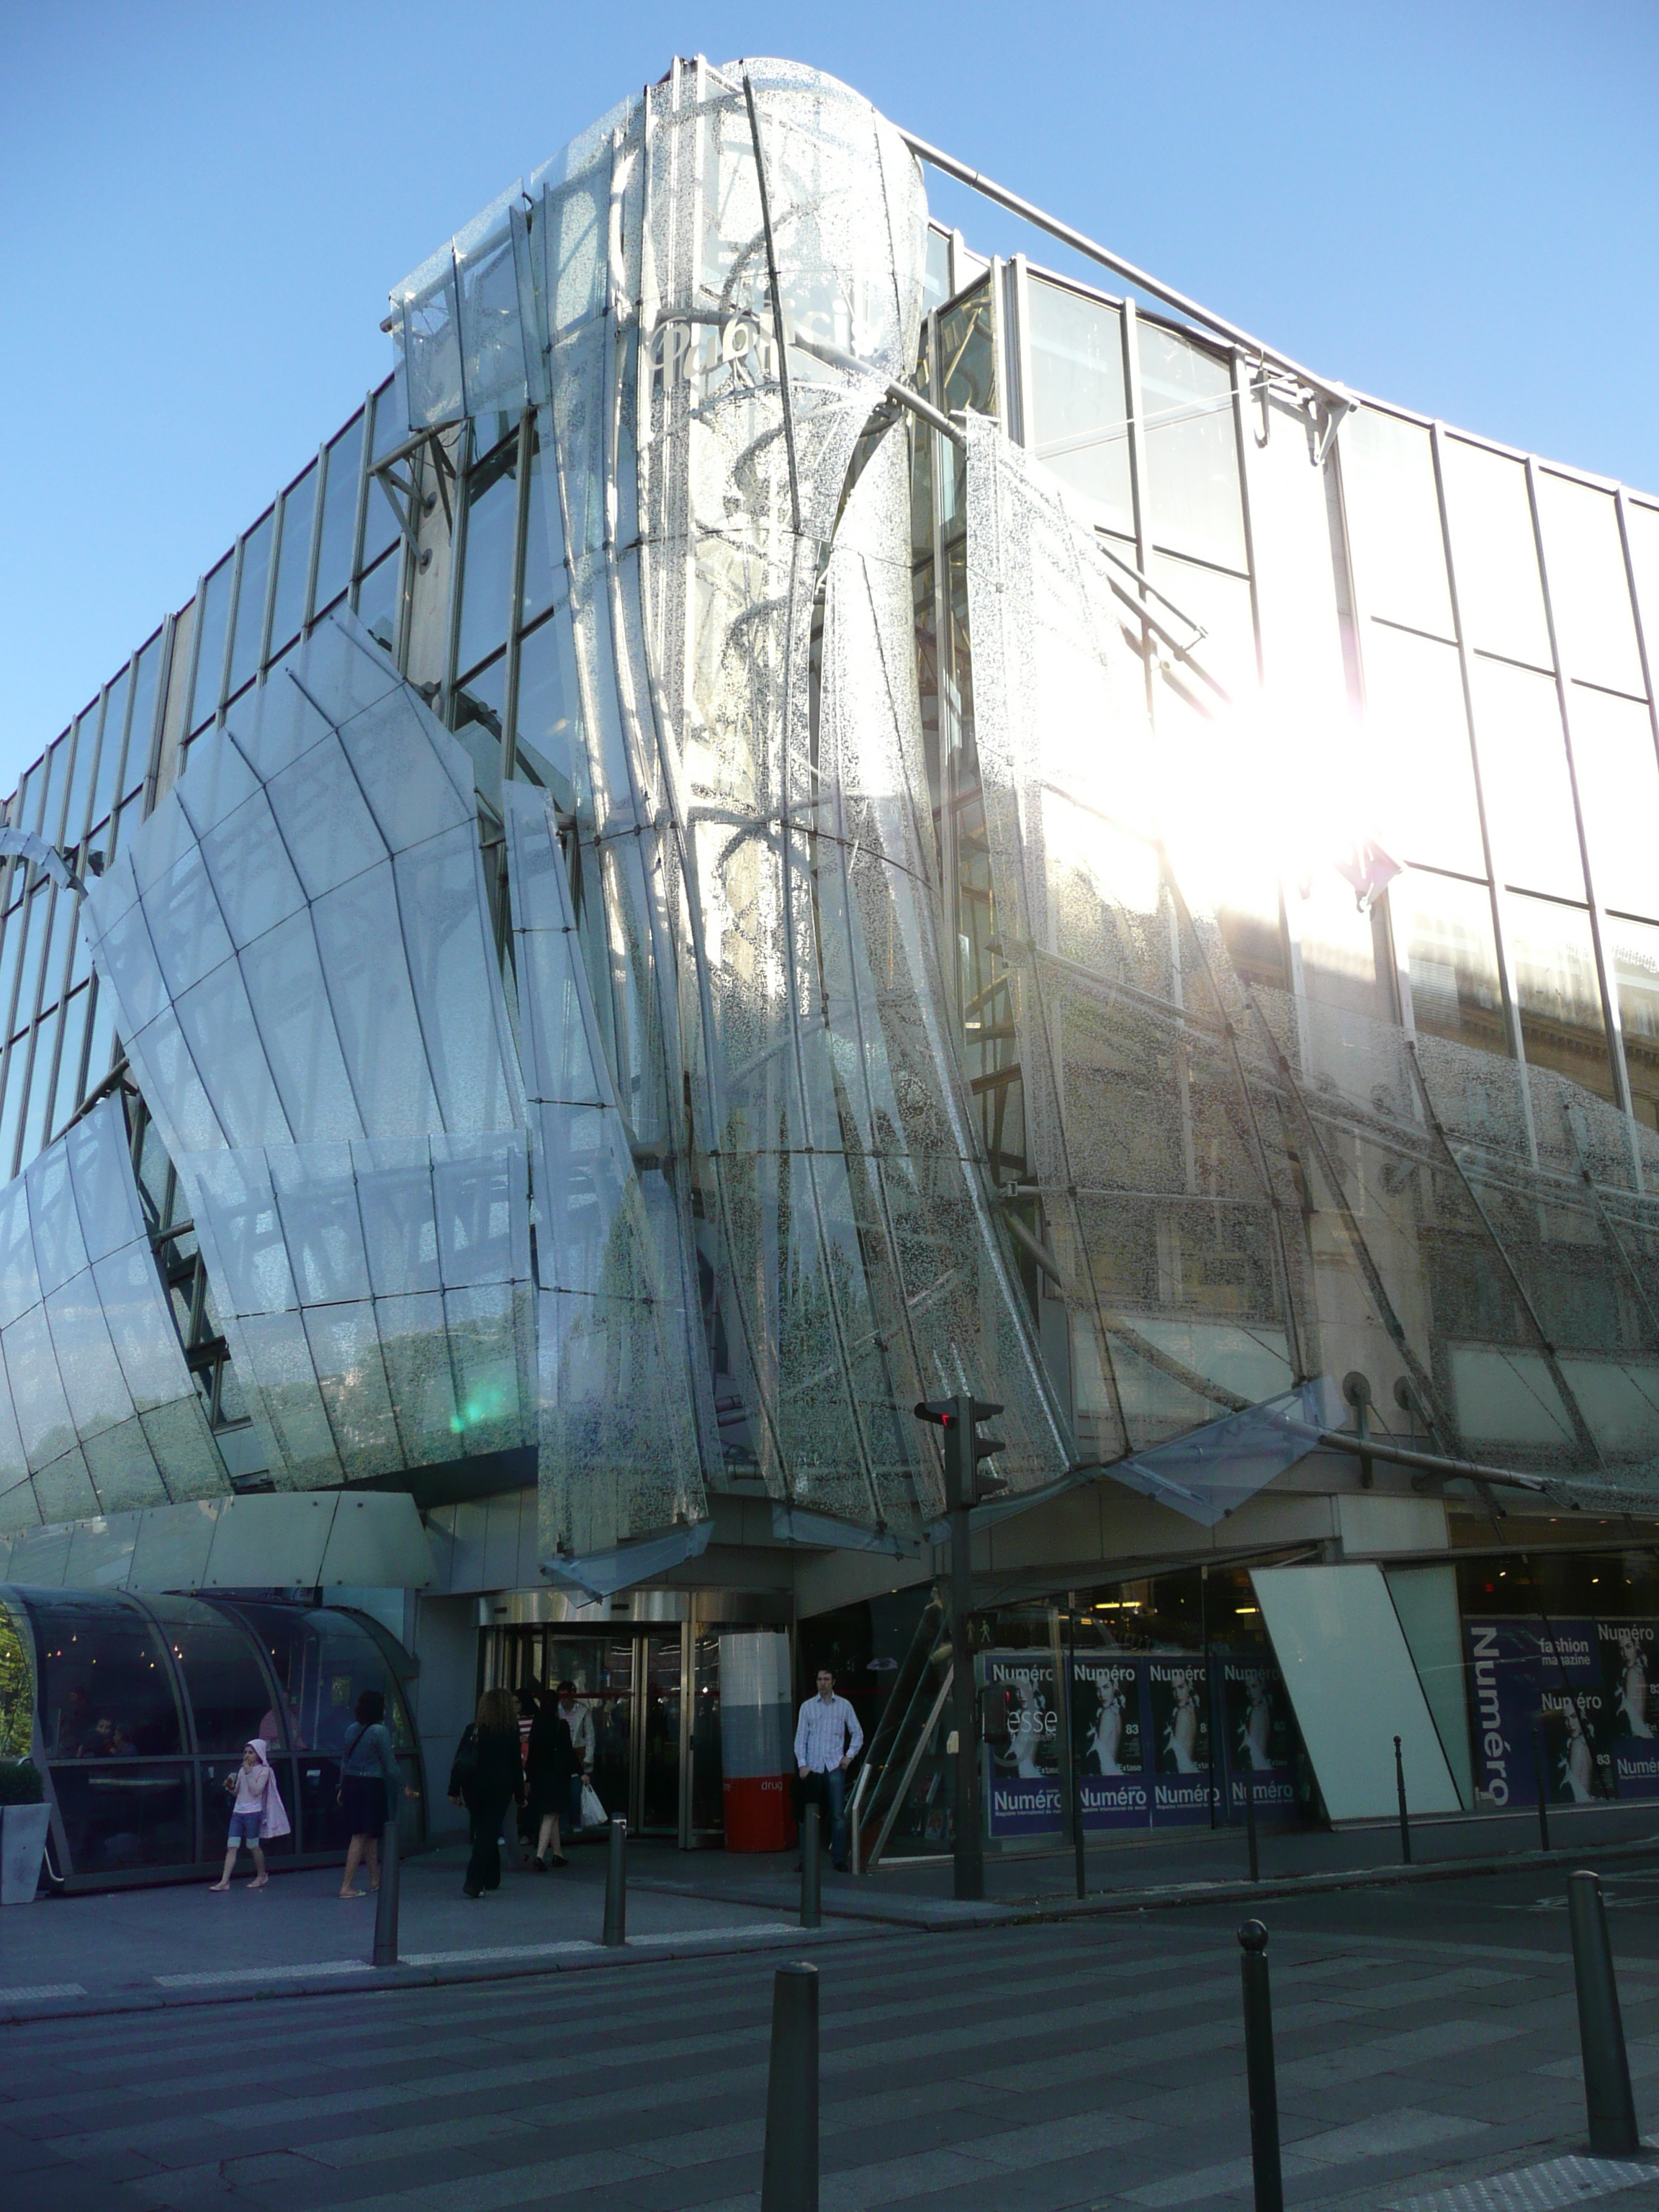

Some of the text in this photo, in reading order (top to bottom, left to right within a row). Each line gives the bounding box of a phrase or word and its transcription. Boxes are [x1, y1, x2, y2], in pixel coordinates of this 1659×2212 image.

[1598, 1624, 1654, 1640] Numéro
[1074, 1664, 1136, 1681] Numéro
[1224, 1664, 1282, 1681] Numéro
[1471, 1627, 1511, 1806] Numéro
[1125, 1724, 1139, 1735] 83
[1118, 1763, 1142, 1772] Extase
[1596, 1753, 1611, 1766] 83
[761, 1781, 783, 1791] drug
[994, 1789, 1061, 1810] Numéro
[1080, 1786, 1147, 1807] Numéro
